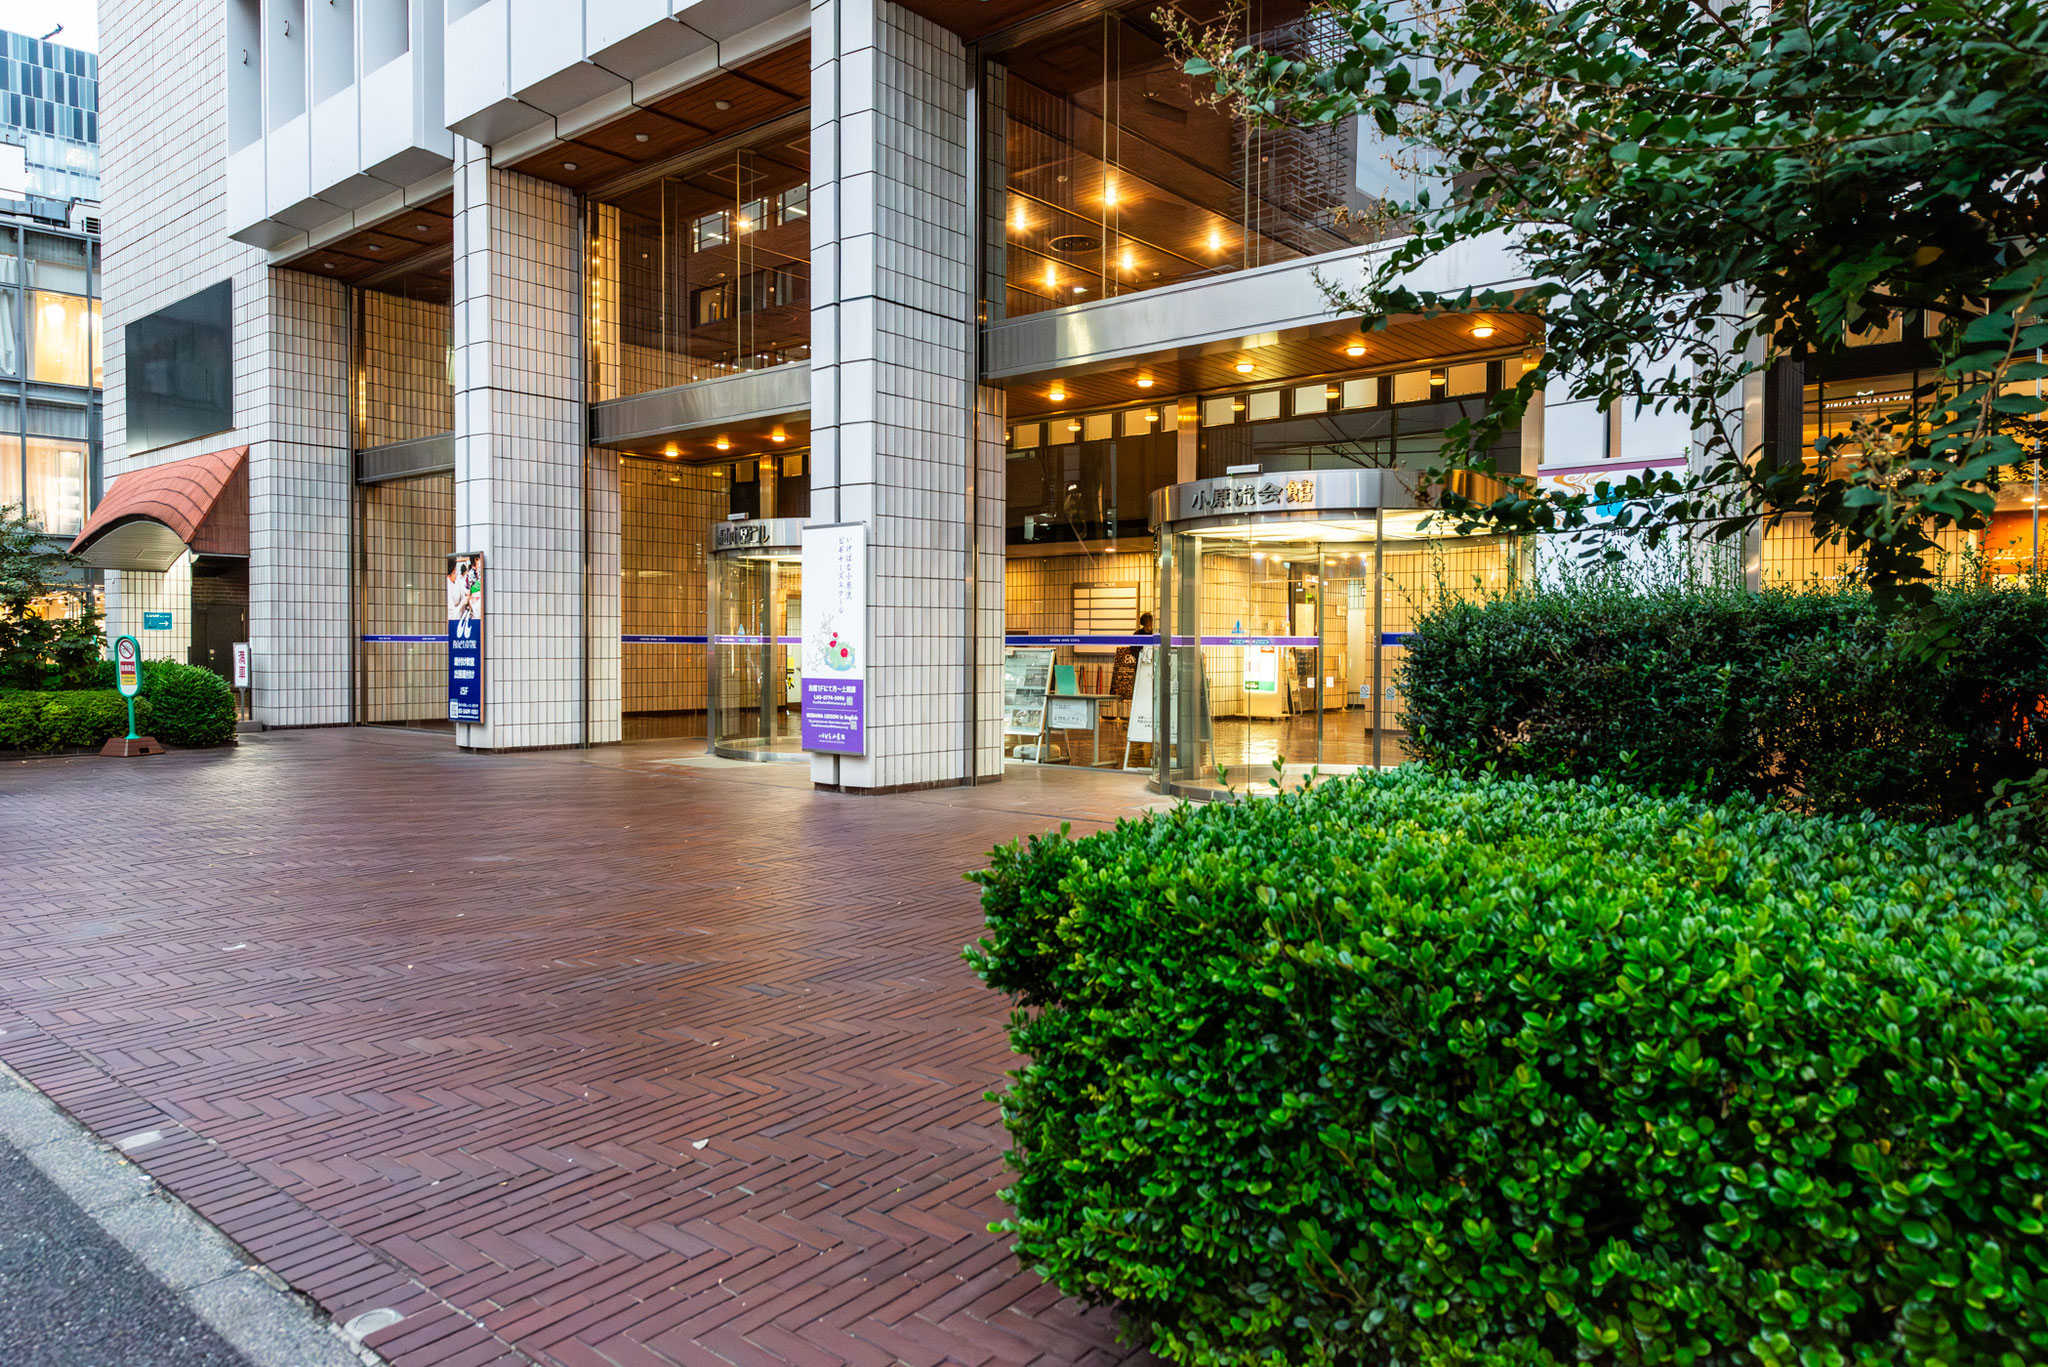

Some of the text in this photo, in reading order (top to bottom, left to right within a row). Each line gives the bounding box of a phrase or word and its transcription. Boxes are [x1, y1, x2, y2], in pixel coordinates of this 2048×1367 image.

[1191, 479, 1314, 510] 小原流会館
